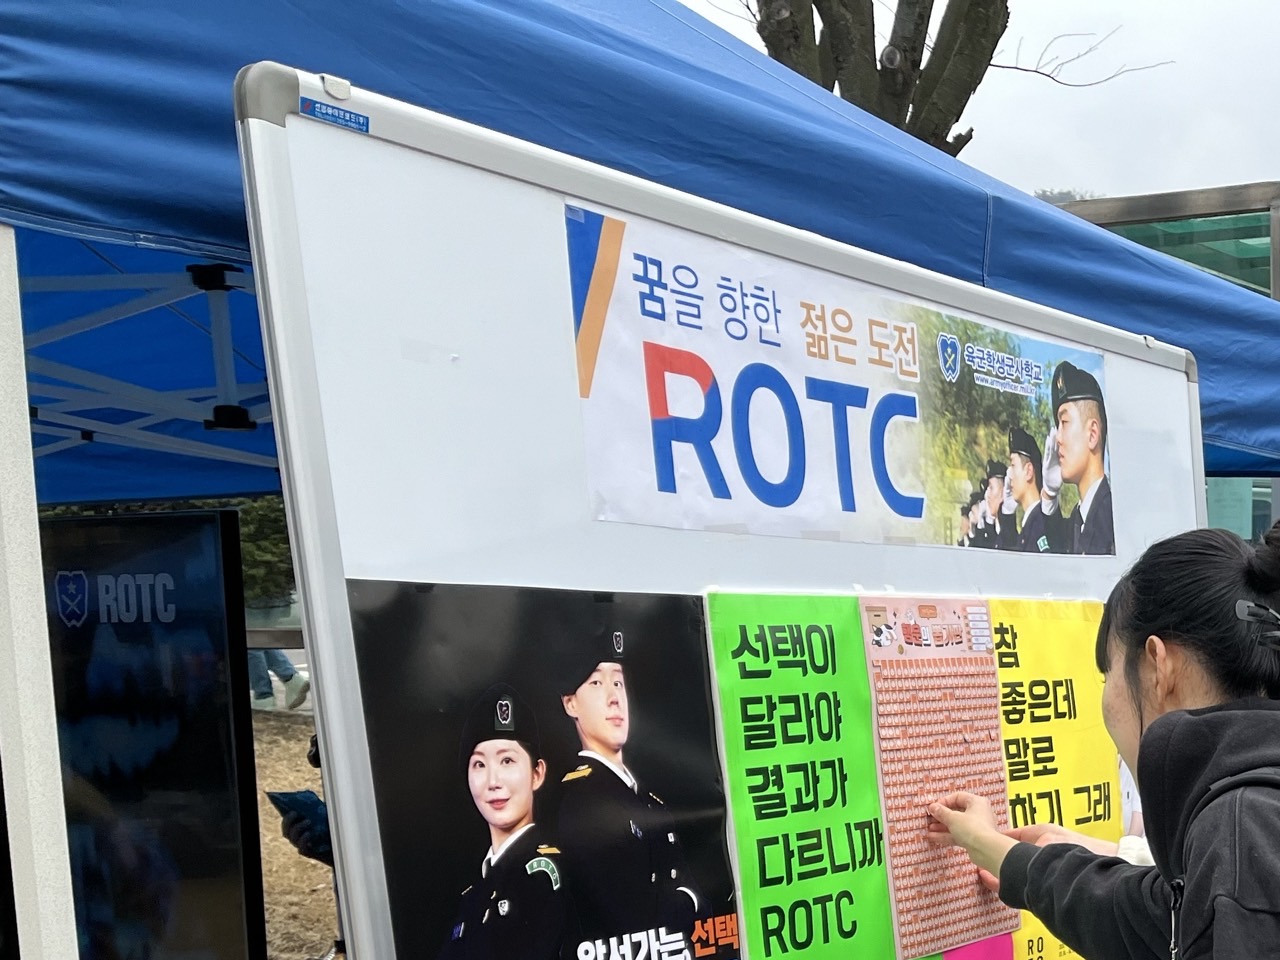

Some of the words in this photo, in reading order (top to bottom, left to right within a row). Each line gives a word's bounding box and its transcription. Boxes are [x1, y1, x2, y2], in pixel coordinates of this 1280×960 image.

[632, 251, 704, 331] 꿈을
[716, 276, 782, 348] 향한
[799, 300, 857, 366] 젊은
[867, 317, 919, 379] 도전
[964, 344, 1043, 383] 육군학생군사학교
[642, 340, 925, 519] ROTC
[97, 573, 176, 624] ROTC
[731, 623, 837, 680] 선택이
[993, 622, 1020, 669] 참
[739, 690, 843, 751] 달라야
[1001, 678, 1077, 725] 좋은데
[1004, 736, 1058, 782] 말로
[744, 757, 848, 821] 결과가
[1009, 789, 1064, 829] 하기
[1073, 782, 1111, 826] 그래
[756, 817, 884, 888] 다르니까
[691, 913, 740, 958] 선택
[760, 889, 858, 958] ROTC
